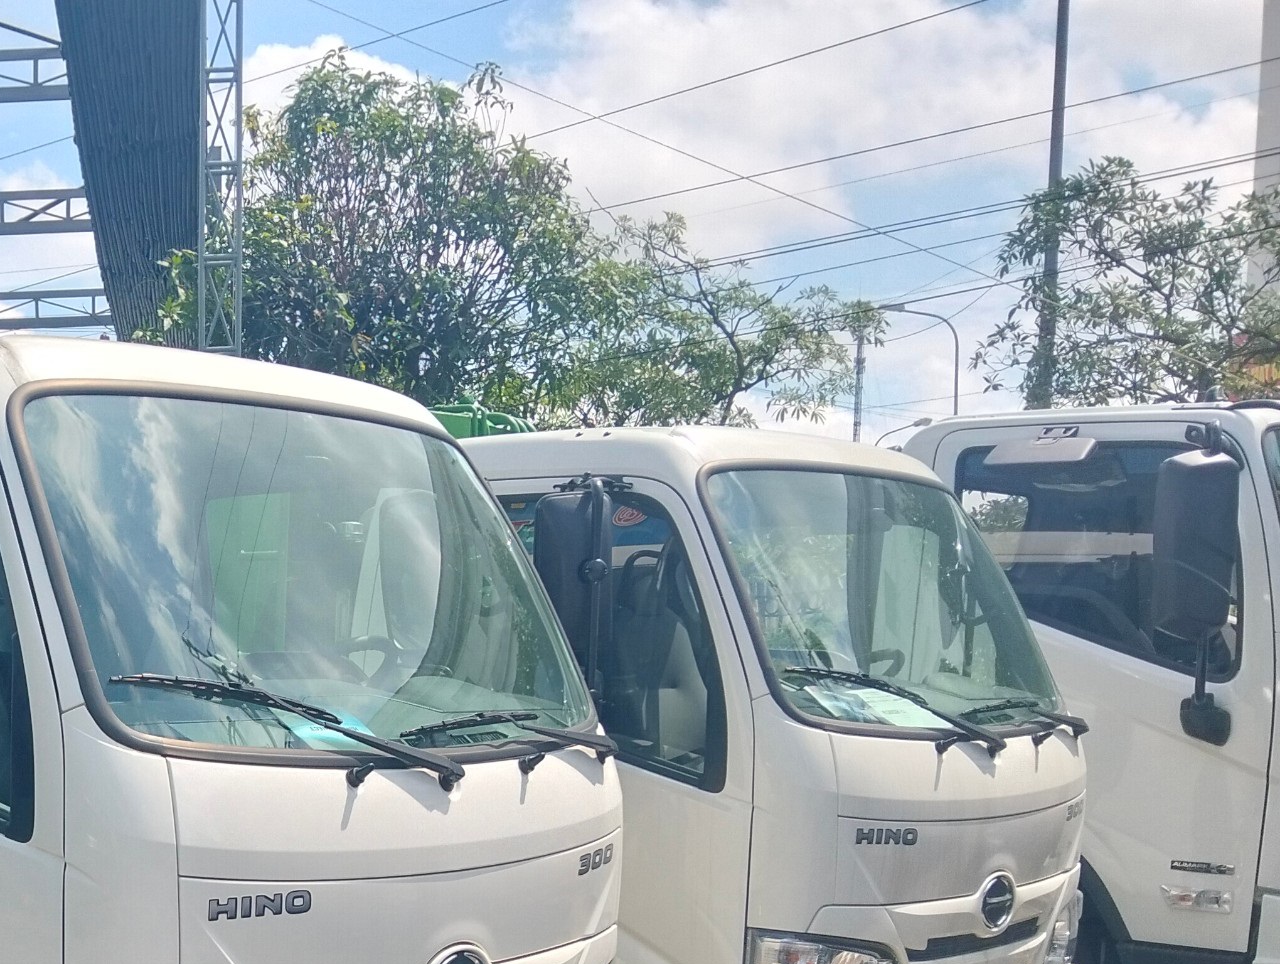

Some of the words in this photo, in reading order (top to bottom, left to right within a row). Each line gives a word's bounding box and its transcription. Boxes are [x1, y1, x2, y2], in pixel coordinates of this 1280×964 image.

[855, 828, 918, 846] HINO
[578, 844, 614, 876] 300
[208, 890, 312, 921] HINO
